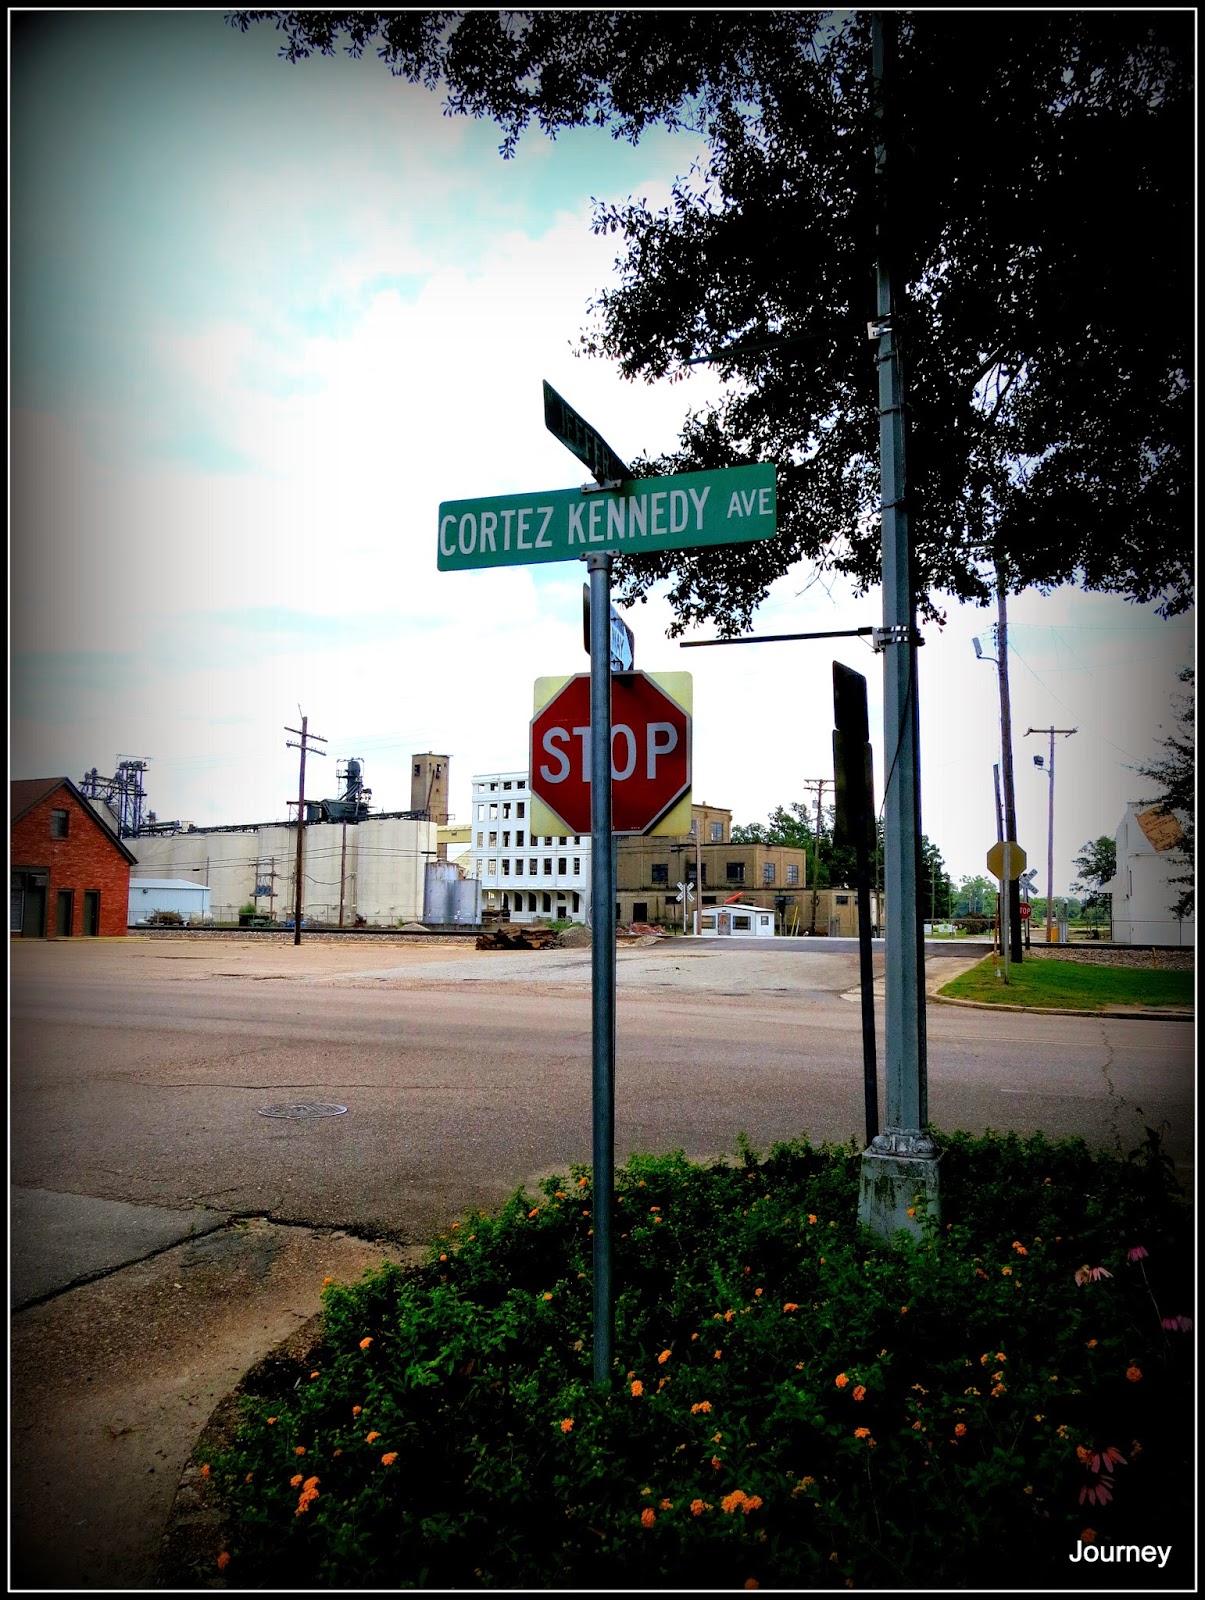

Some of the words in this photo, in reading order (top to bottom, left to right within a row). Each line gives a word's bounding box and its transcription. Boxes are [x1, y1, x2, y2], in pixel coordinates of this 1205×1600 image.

[439, 506, 553, 557] CORTEZ
[567, 486, 711, 545] KENNEDY
[726, 487, 774, 519] AVE
[539, 721, 678, 784] STOP
[1019, 906, 1031, 915] TOP
